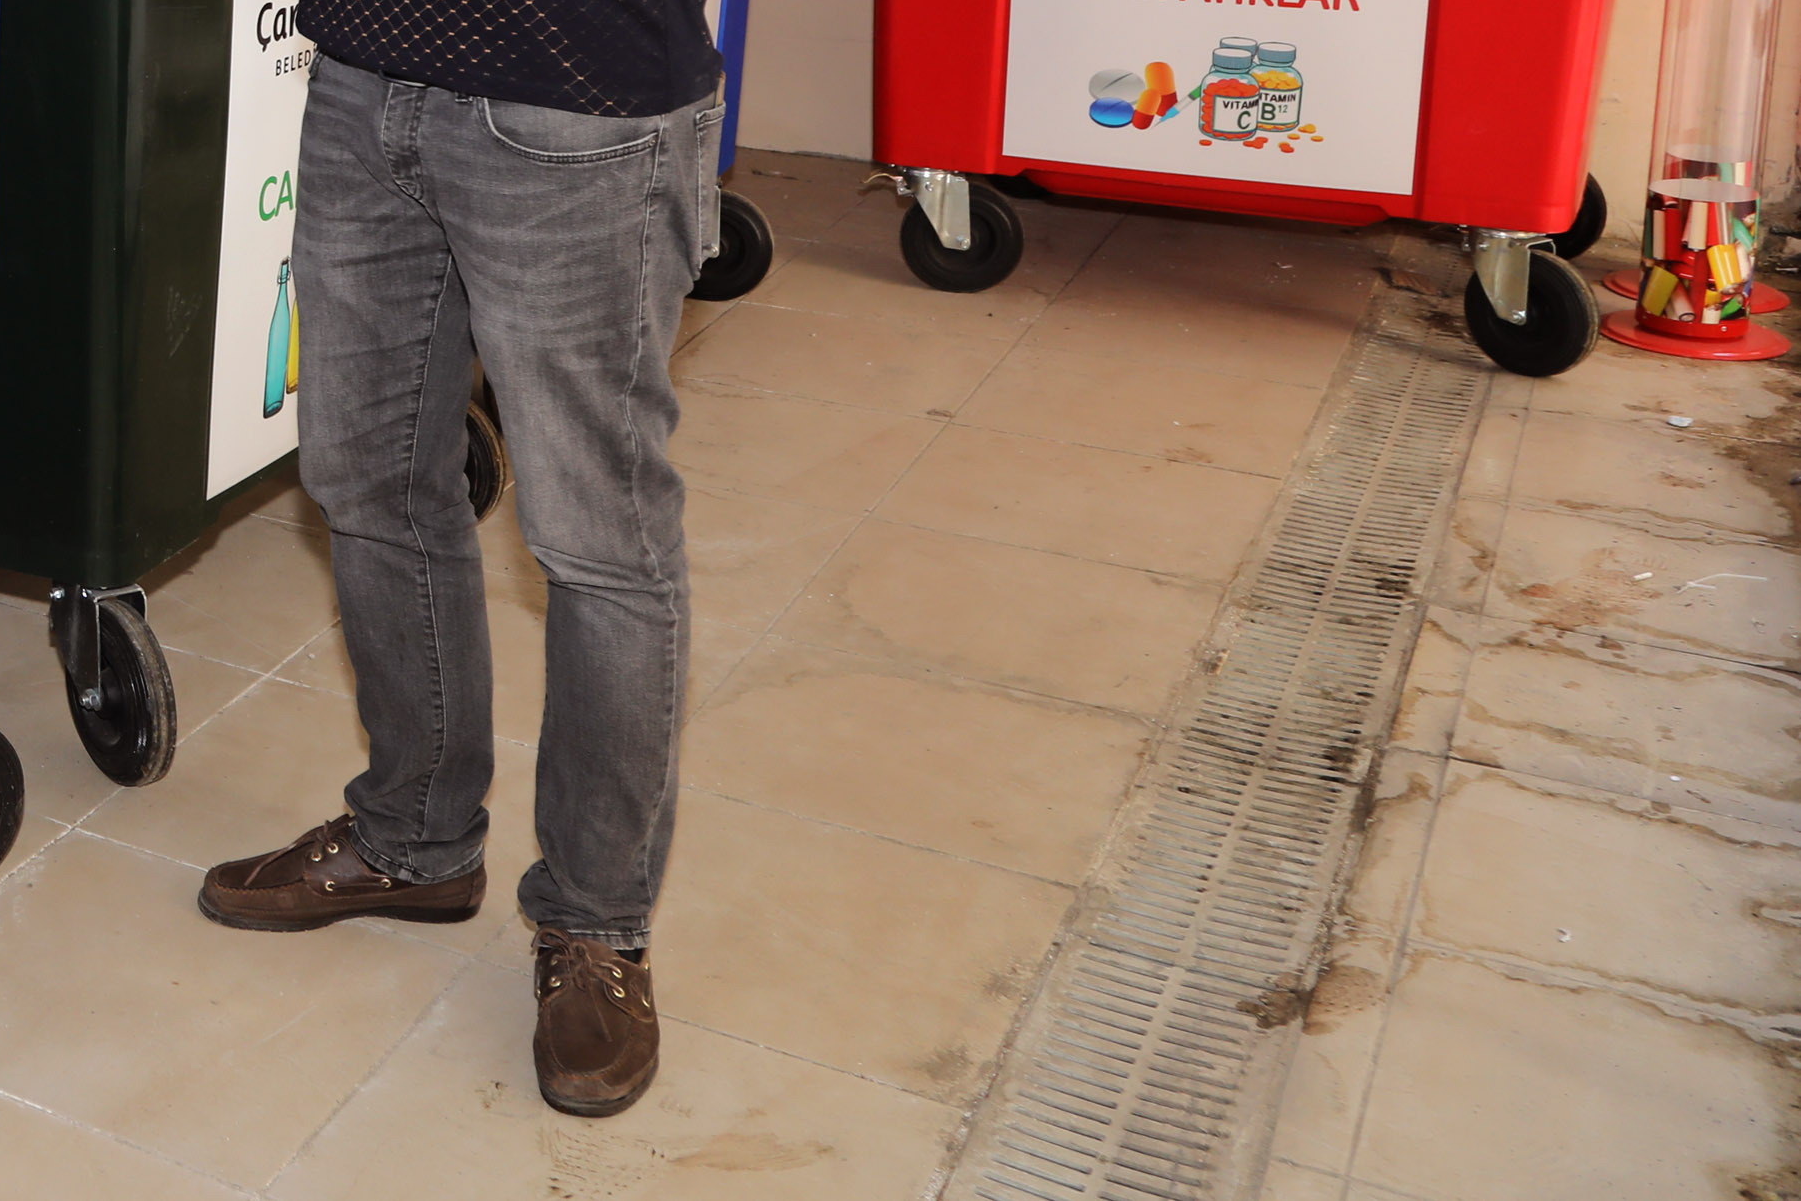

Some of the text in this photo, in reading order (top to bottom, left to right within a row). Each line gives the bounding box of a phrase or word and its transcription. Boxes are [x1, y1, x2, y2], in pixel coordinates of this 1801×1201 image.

[275, 43, 317, 76] BELED
[1237, 110, 1251, 130] C
[259, 170, 294, 222] CA
